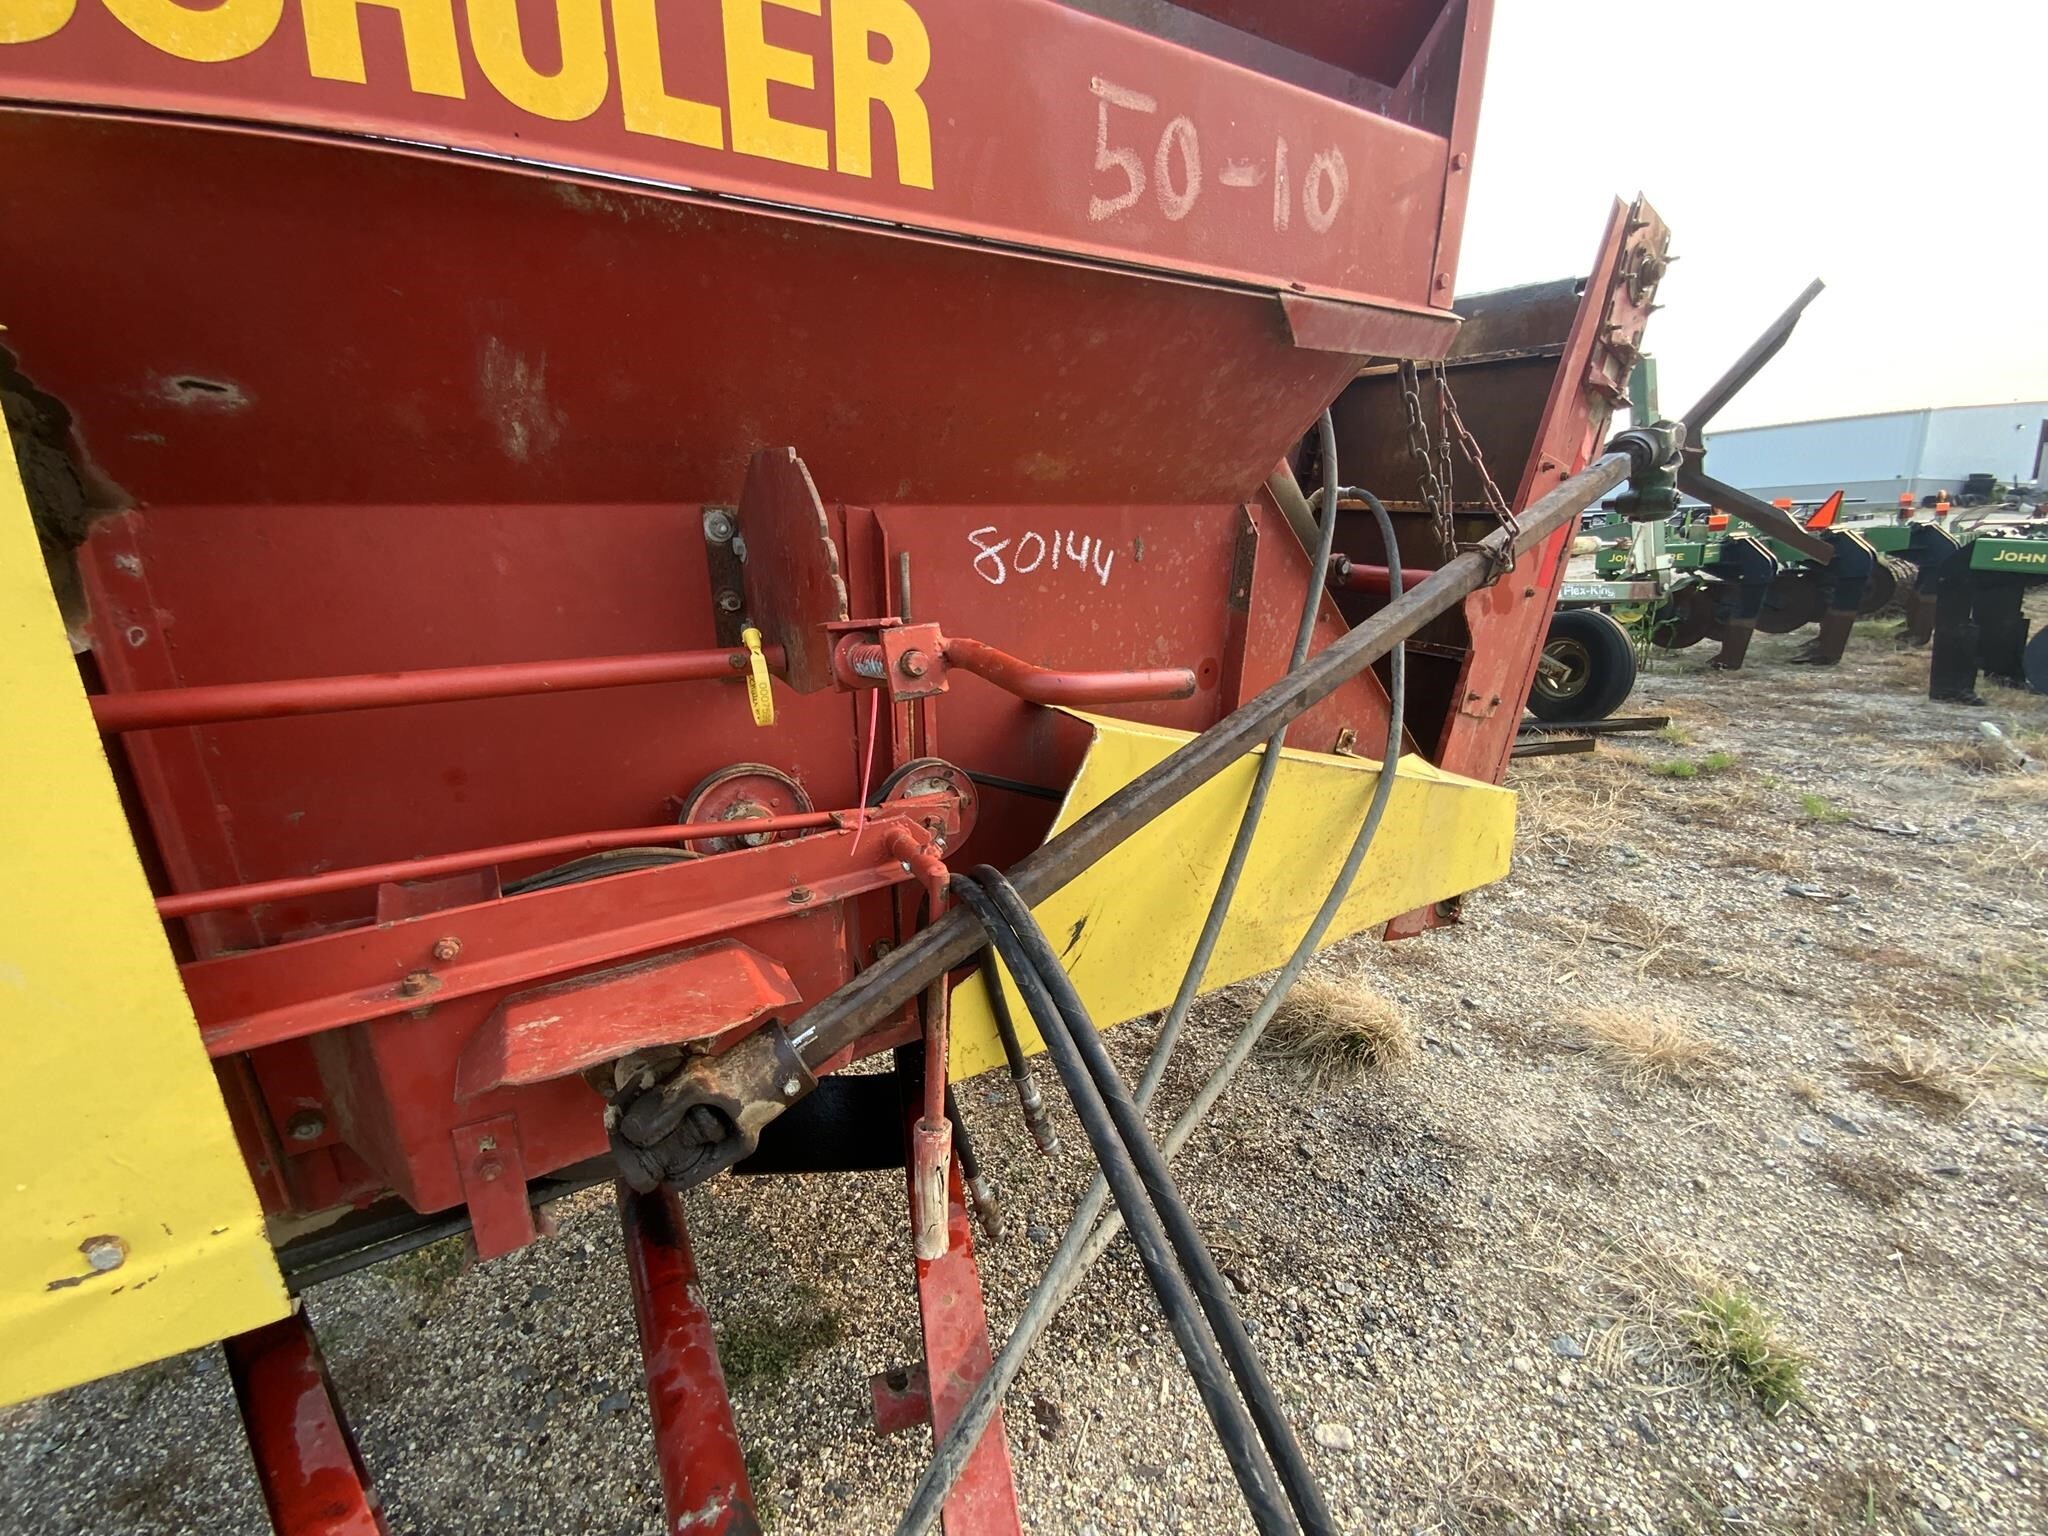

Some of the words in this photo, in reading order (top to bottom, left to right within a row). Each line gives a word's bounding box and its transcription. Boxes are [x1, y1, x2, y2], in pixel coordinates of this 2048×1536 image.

[1088, 76, 1349, 233] 50-10
[968, 526, 1114, 586] 80144
[1993, 549, 2047, 564] JOHN
